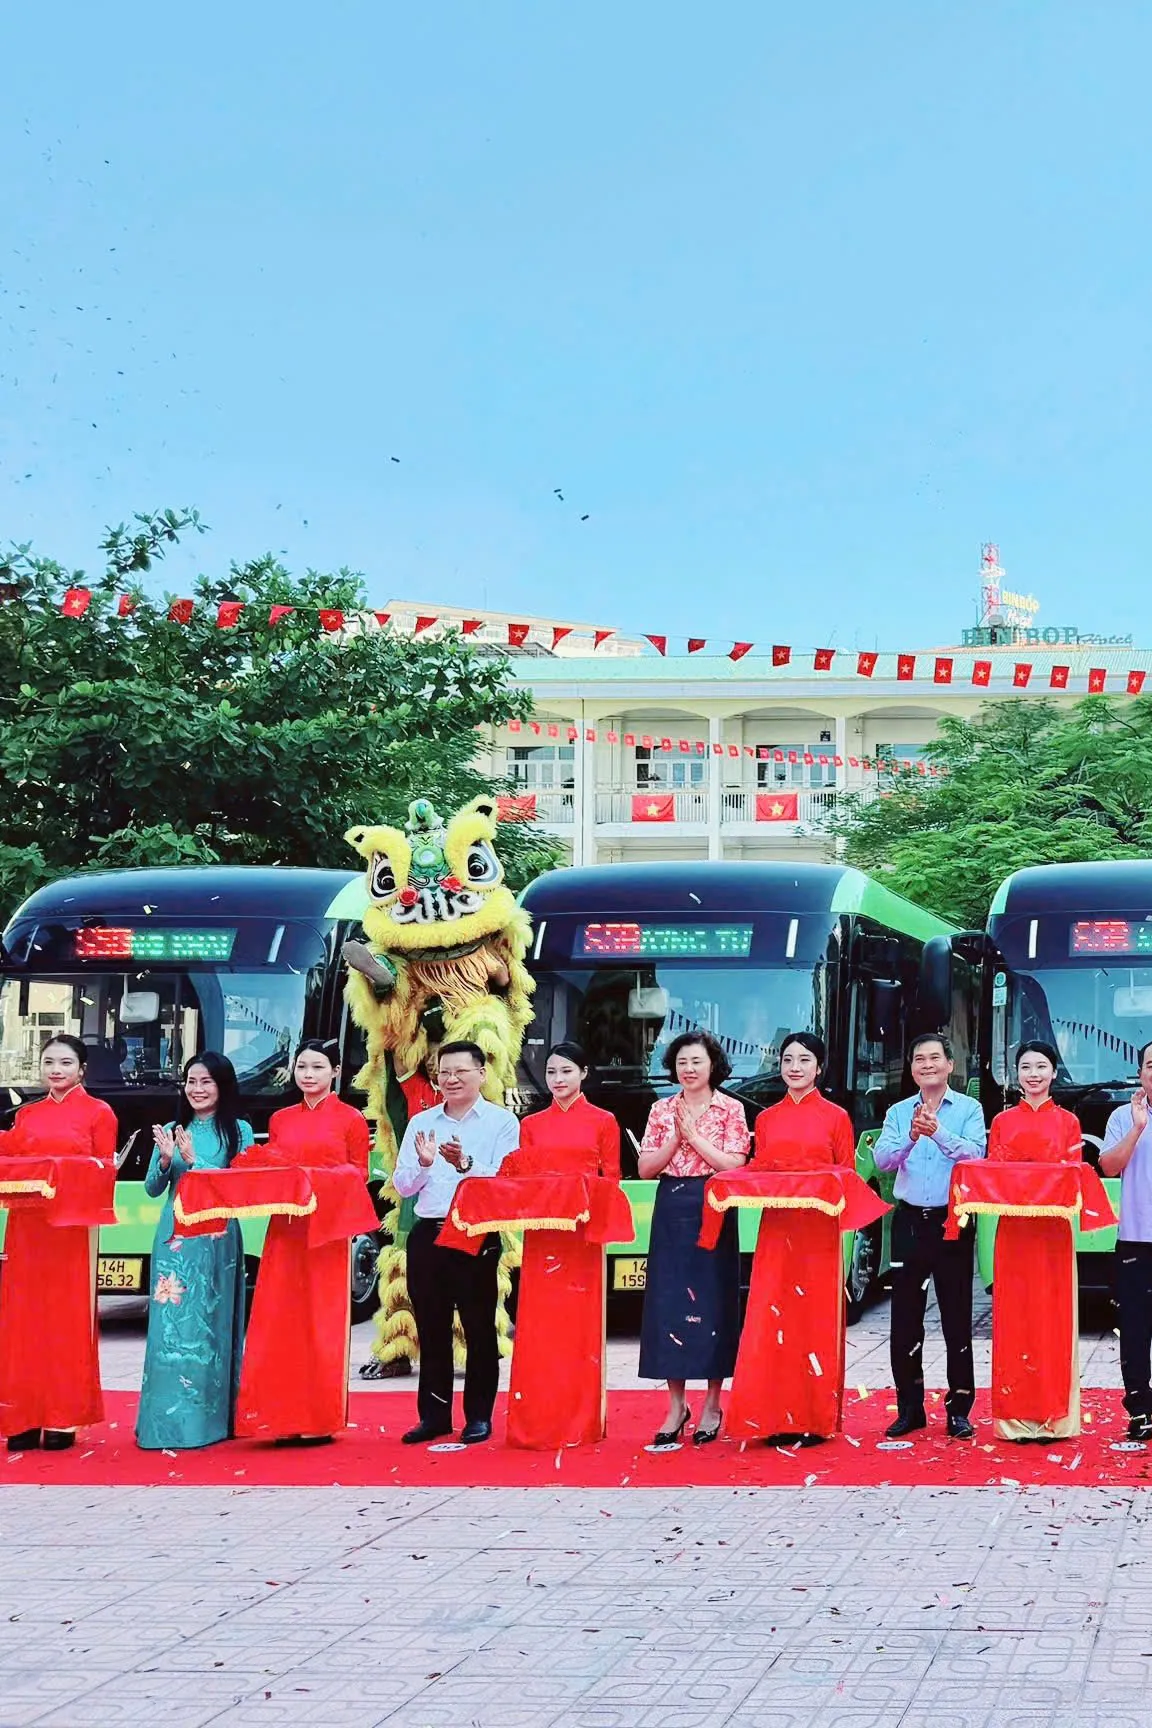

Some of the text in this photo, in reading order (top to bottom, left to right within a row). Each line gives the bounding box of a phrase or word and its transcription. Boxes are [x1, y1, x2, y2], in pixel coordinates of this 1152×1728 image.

[102, 1260, 125, 1273] 14H
[633, 1260, 647, 1273] 14
[97, 1274, 134, 1287] 56.32
[622, 1274, 645, 1287] 159
